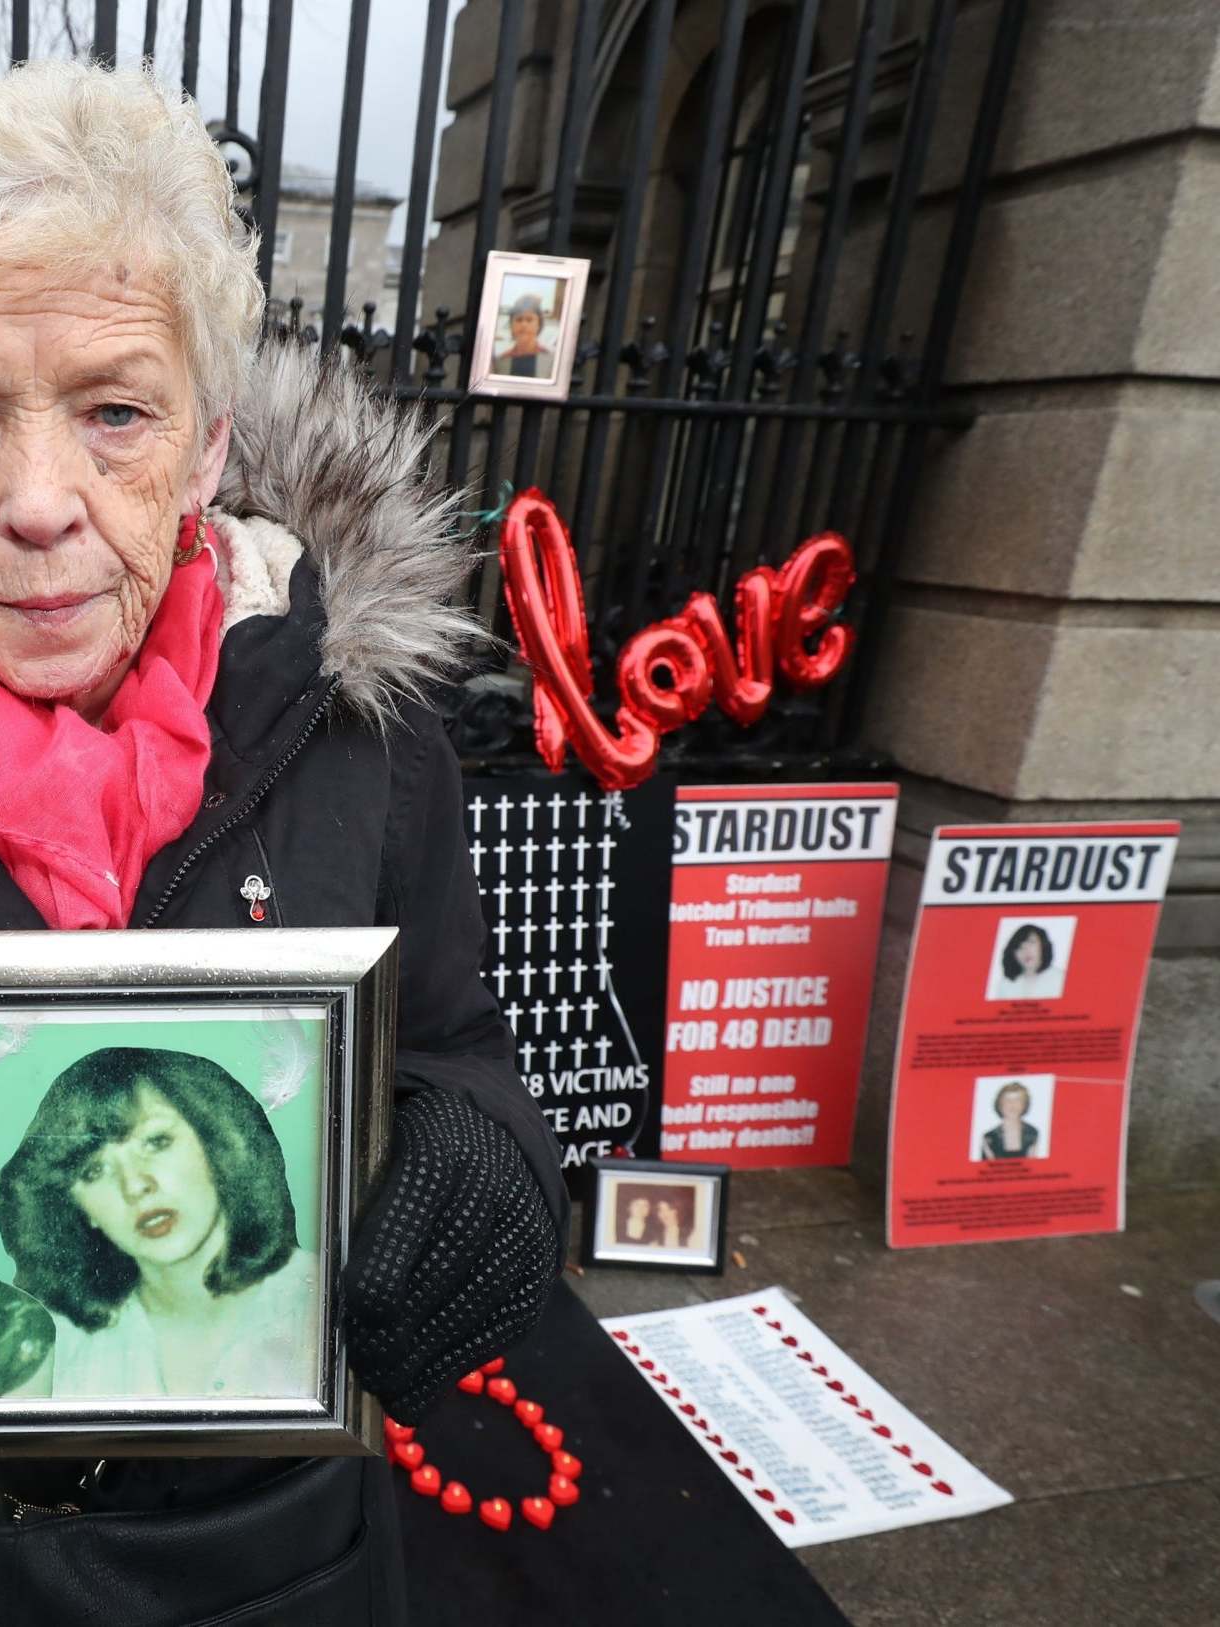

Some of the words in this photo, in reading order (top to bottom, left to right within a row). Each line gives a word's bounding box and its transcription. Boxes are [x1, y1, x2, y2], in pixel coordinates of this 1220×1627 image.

[674, 806, 882, 855] STARDUST
[942, 844, 1161, 894] STARDUST
[705, 926, 745, 947] True
[680, 980, 718, 1011] NO
[721, 976, 829, 1009] JUSTICE
[666, 1021, 718, 1052] FOR
[721, 1019, 758, 1050] 48
[762, 1017, 833, 1047] DEAD
[522, 1073, 544, 1098] 8
[549, 1064, 649, 1096] VICTIMS
[689, 1074, 729, 1097] Still
[730, 1076, 757, 1095] no
[758, 1074, 796, 1094] one
[574, 1102, 632, 1131] AND
